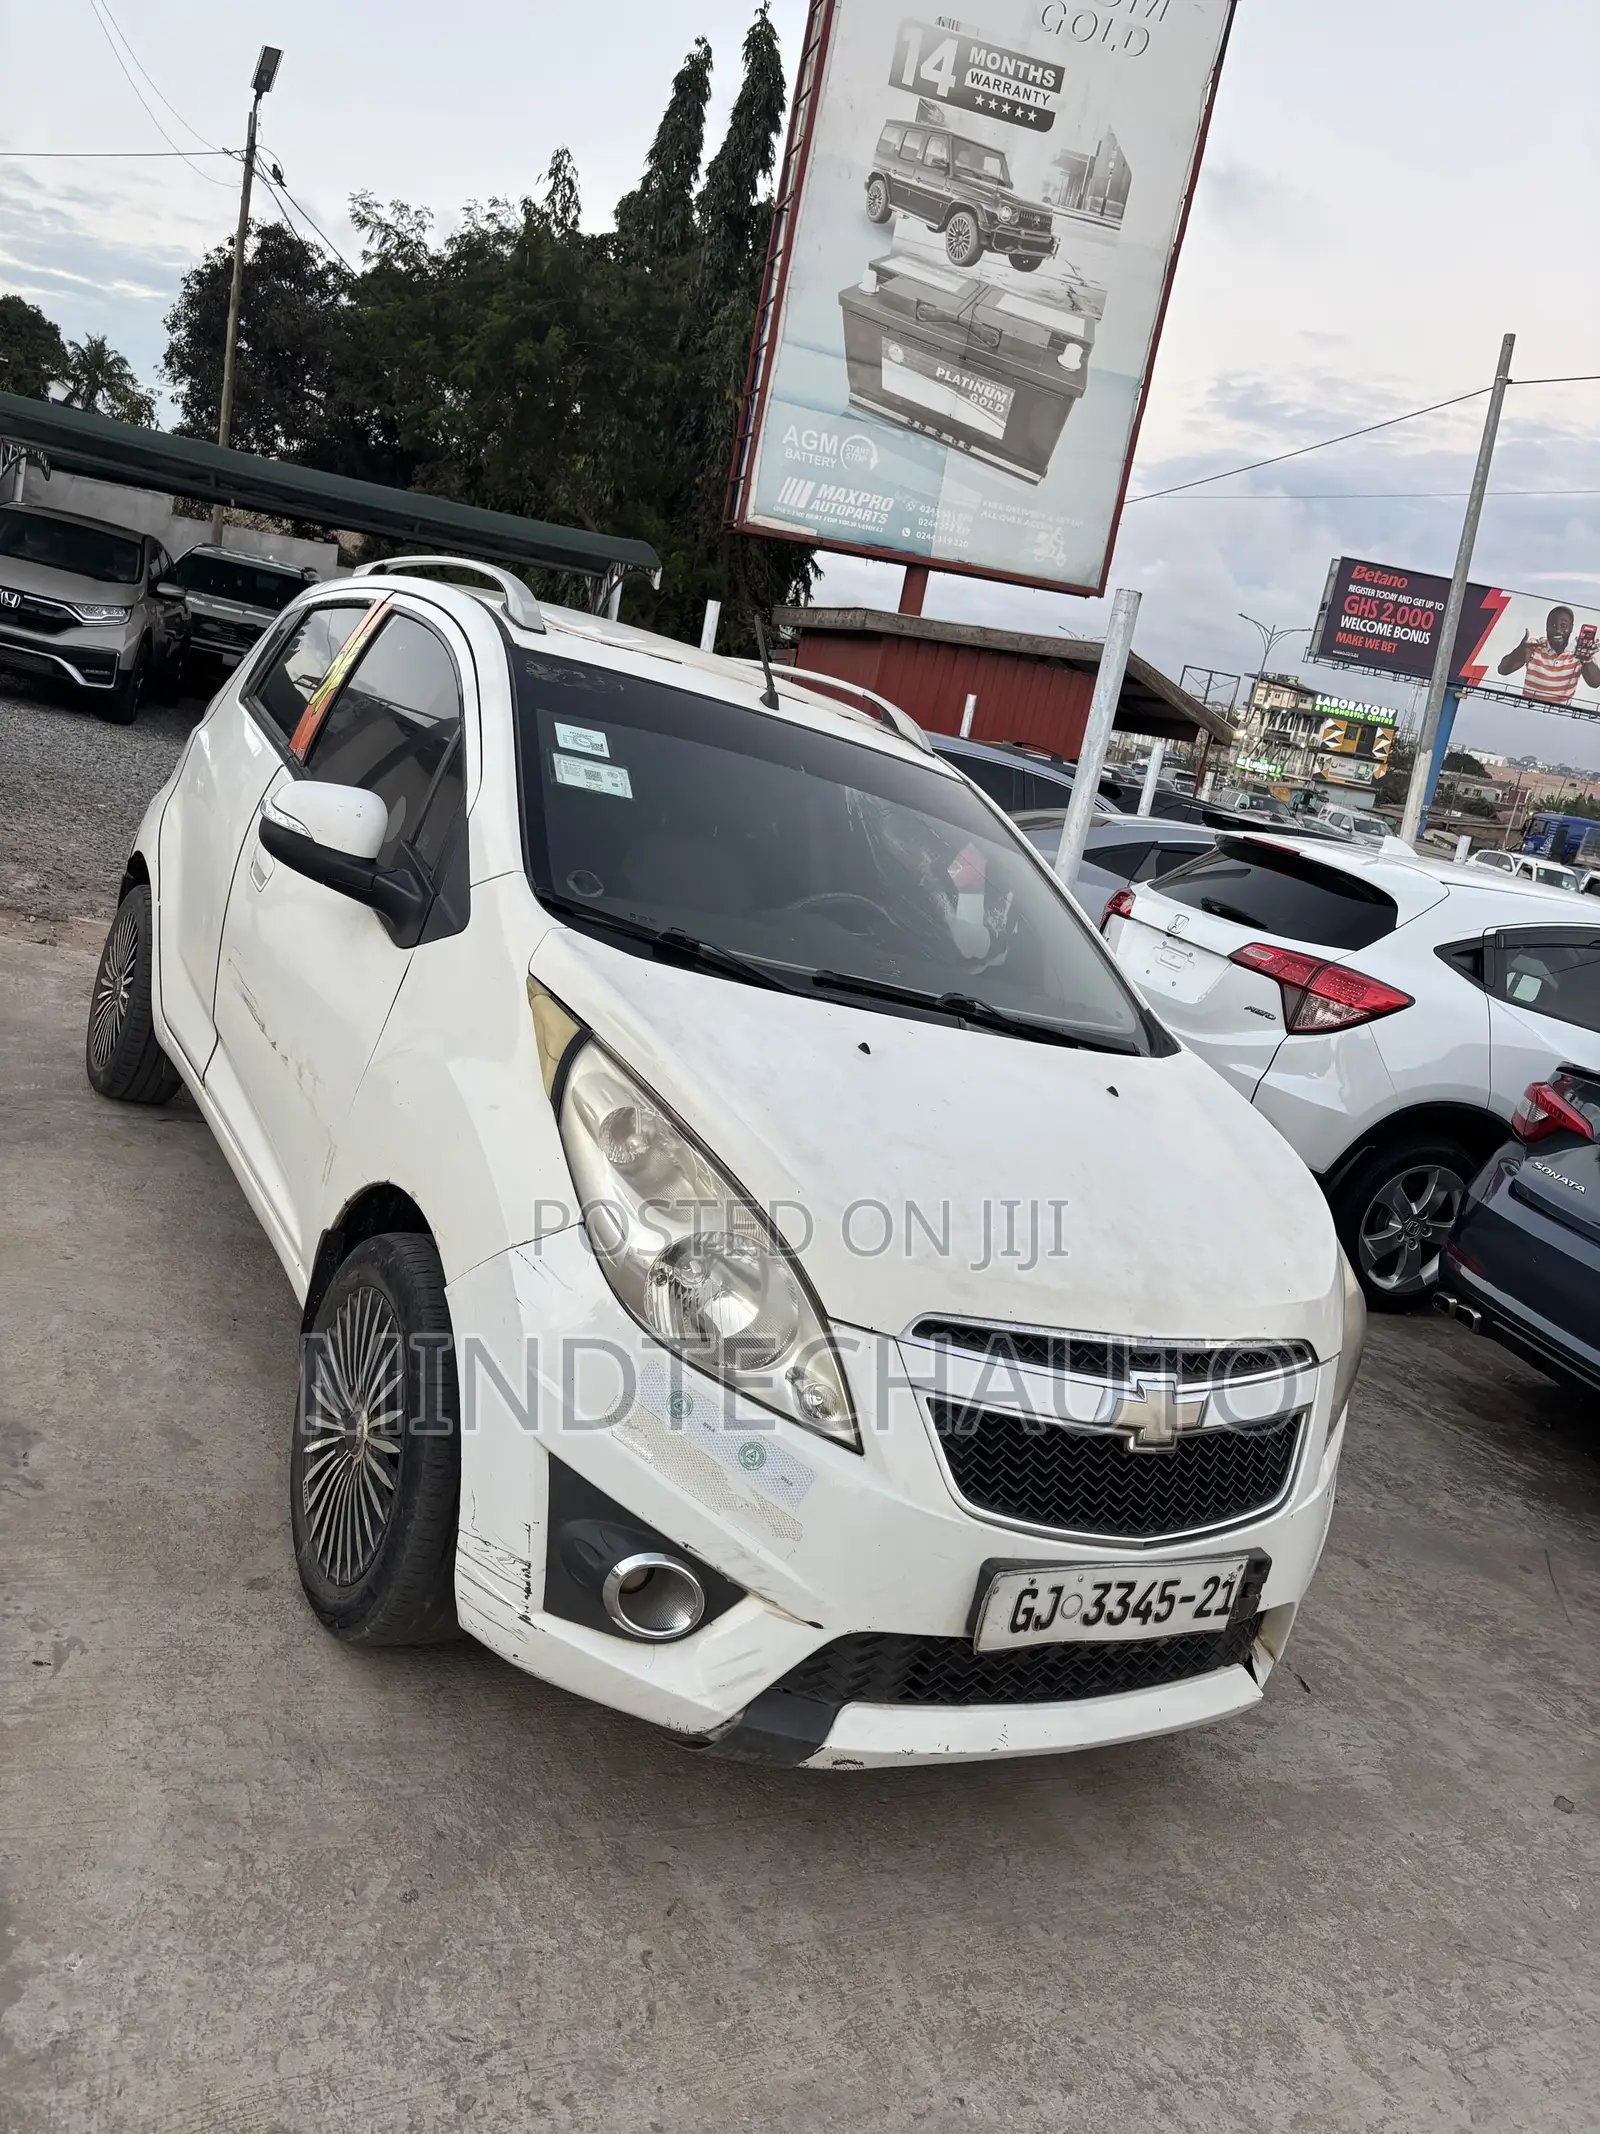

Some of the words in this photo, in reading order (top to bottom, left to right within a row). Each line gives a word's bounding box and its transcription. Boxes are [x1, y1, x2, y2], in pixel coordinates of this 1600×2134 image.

[1041, 0, 1150, 57] GOLD
[901, 27, 958, 98] 14
[969, 46, 1056, 88] MONTHS
[970, 71, 1051, 106] WARRANTY
[936, 366, 1008, 404] PLATINUM
[970, 392, 1005, 413] GOLD
[782, 424, 839, 456] AGM
[785, 448, 838, 469] BATTERY
[810, 499, 889, 525] AUTOPARTS
[817, 483, 895, 512] MAXPRO
[1351, 565, 1408, 589] Betano
[1348, 584, 1376, 597] REGISTER
[1376, 589, 1399, 601] TODAY
[1398, 594, 1413, 605] AND
[1413, 598, 1426, 608] GET
[1425, 600, 1435, 609] UP
[1434, 601, 1445, 611] TO
[1343, 595, 1379, 620] GHS
[1379, 602, 1434, 631] 2,000
[1335, 631, 1364, 649] MAKE
[1364, 637, 1381, 650] WE
[1381, 641, 1398, 654] BET
[1340, 615, 1393, 637] WELCOME
[1393, 626, 1431, 645] BONUS
[1315, 694, 1396, 719] LABORATORY
[1322, 705, 1365, 720] DIAGNOSTIC
[1243, 1005, 1277, 1021] AWD
[1532, 1161, 1586, 1194] SONATA
[1009, 1584, 1065, 1634] GJ
[1080, 1575, 1234, 1627] 3345-21
